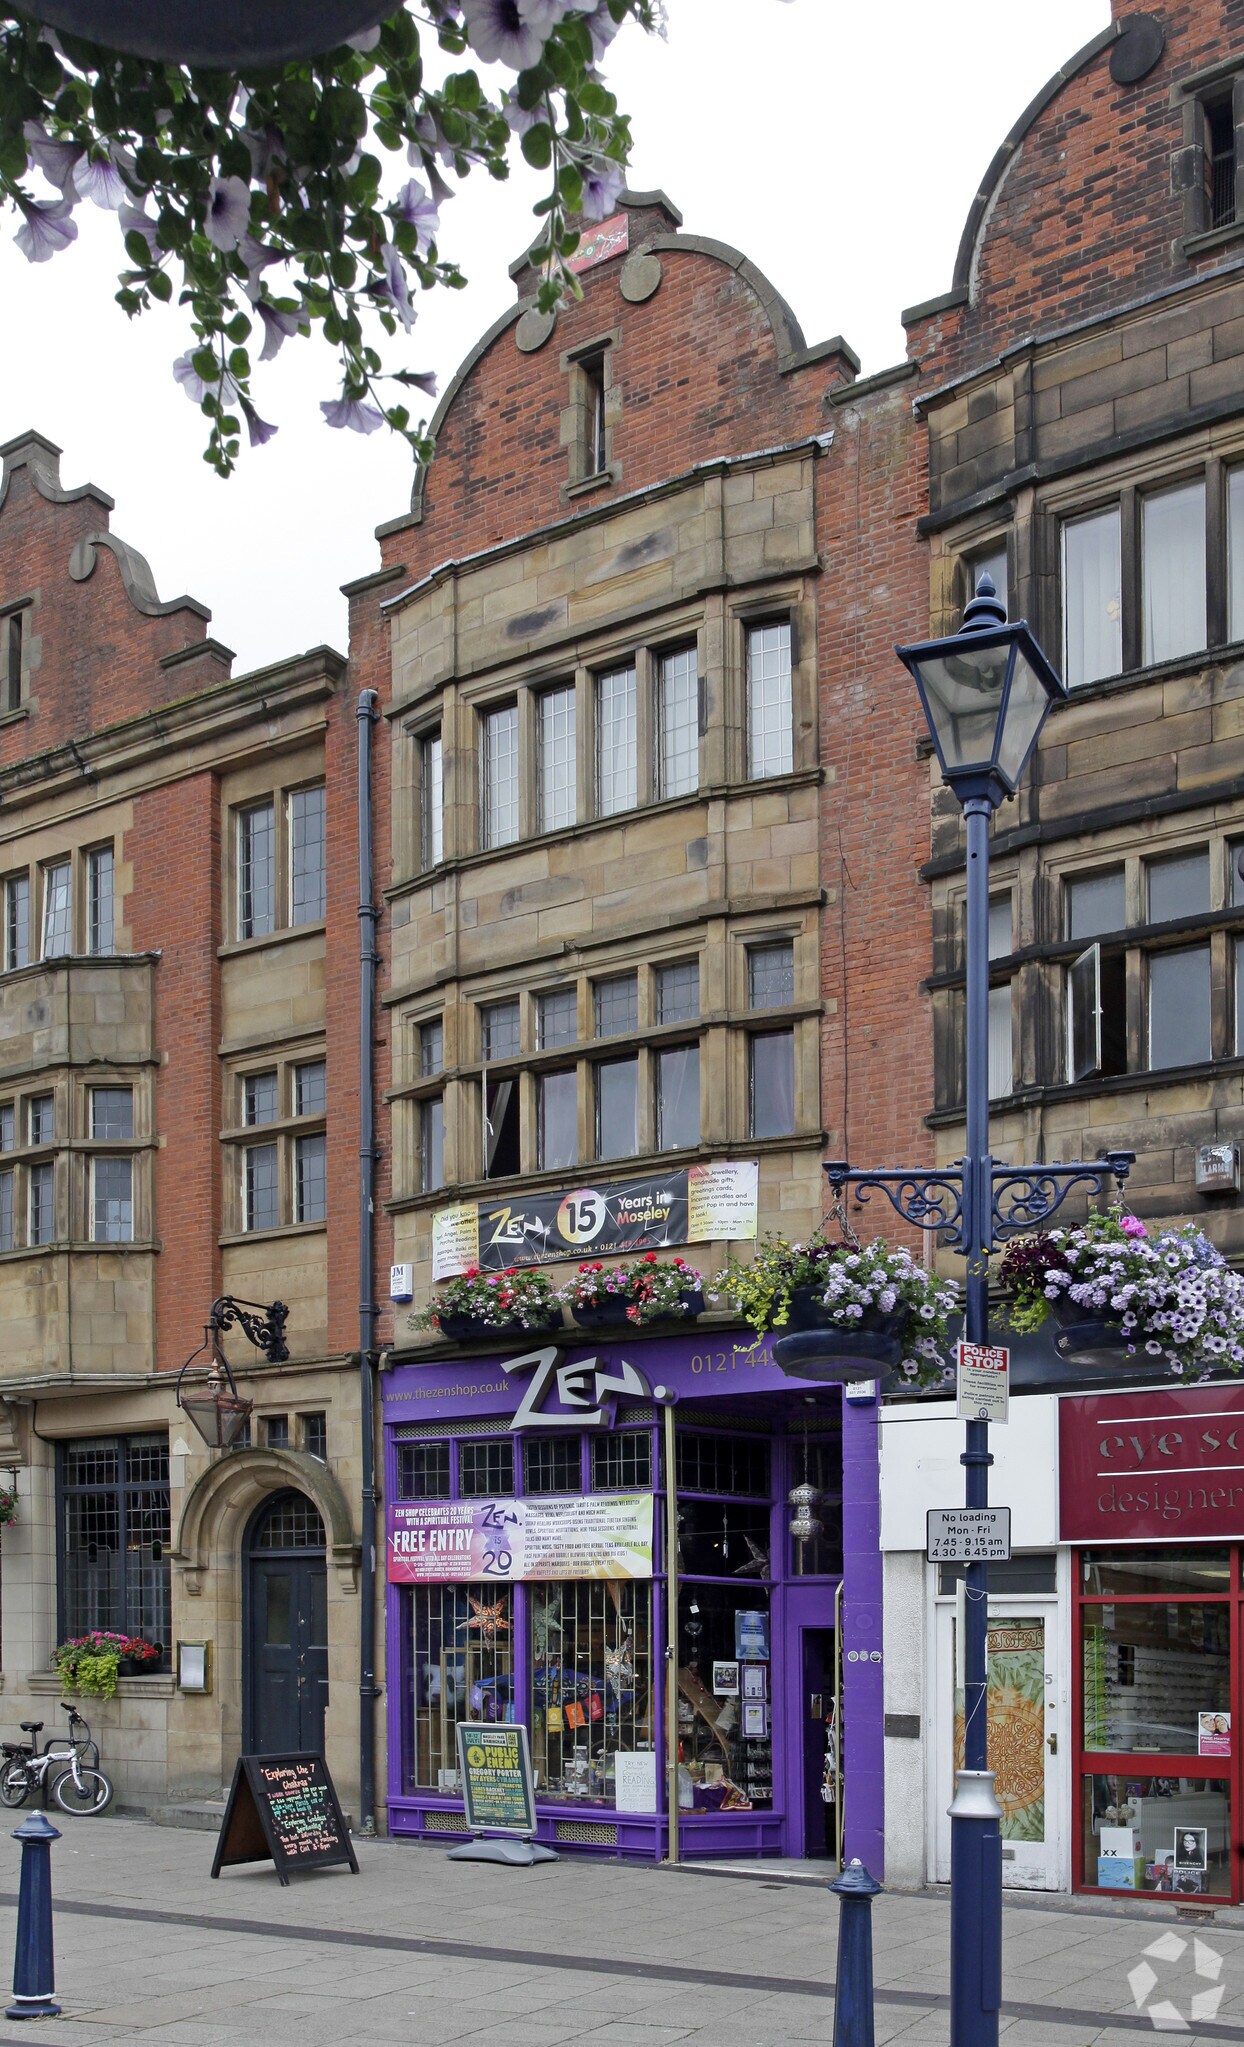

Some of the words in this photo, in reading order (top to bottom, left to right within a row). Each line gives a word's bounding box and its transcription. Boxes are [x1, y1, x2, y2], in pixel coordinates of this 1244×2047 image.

[690, 1177, 720, 1187] handmade
[618, 1194, 653, 1211] Years
[706, 1202, 718, 1210] Pop
[739, 1200, 755, 1208] have
[460, 1209, 477, 1219] know
[566, 1199, 597, 1234] 15
[617, 1206, 671, 1226] Moseley
[455, 1235, 477, 1245] Readings
[600, 1241, 618, 1252] 0121
[963, 1345, 1004, 1360] POLICE
[691, 1350, 737, 1375] 0121
[963, 1354, 1004, 1371] STOP
[385, 1379, 510, 1402] www.thezenshop.co.uk
[1099, 1431, 1184, 1469] eye
[395, 1508, 405, 1518] ZEN
[405, 1508, 419, 1518] SHOP
[419, 1507, 450, 1517] CELEBRATES
[450, 1507, 457, 1516] 20
[457, 1506, 474, 1515] YEARS
[942, 1513, 956, 1522] No
[959, 1512, 997, 1524] loading
[406, 1516, 419, 1526] WITH
[419, 1516, 424, 1525] A
[424, 1515, 450, 1525] SPIRITUAL
[450, 1514, 474, 1524] FESTIVAL
[947, 1526, 969, 1535] Mon
[977, 1525, 991, 1534] Fri
[393, 1530, 426, 1553] FREE
[429, 1529, 474, 1552] ENTRY
[934, 1538, 957, 1547] 7.45
[965, 1537, 986, 1546] 9.15
[988, 1538, 1003, 1546] am
[932, 1548, 957, 1557] 4.30
[964, 1547, 988, 1556] 6.45
[990, 1549, 1006, 1557] pm
[482, 1550, 513, 1576] 20
[485, 1746, 519, 1758] PUBLIC
[296, 1765, 309, 1775] the
[309, 1763, 315, 1773] 7
[486, 1757, 519, 1769] ENEMY
[468, 1767, 496, 1776] GREGORY
[496, 1769, 522, 1777] PORTER
